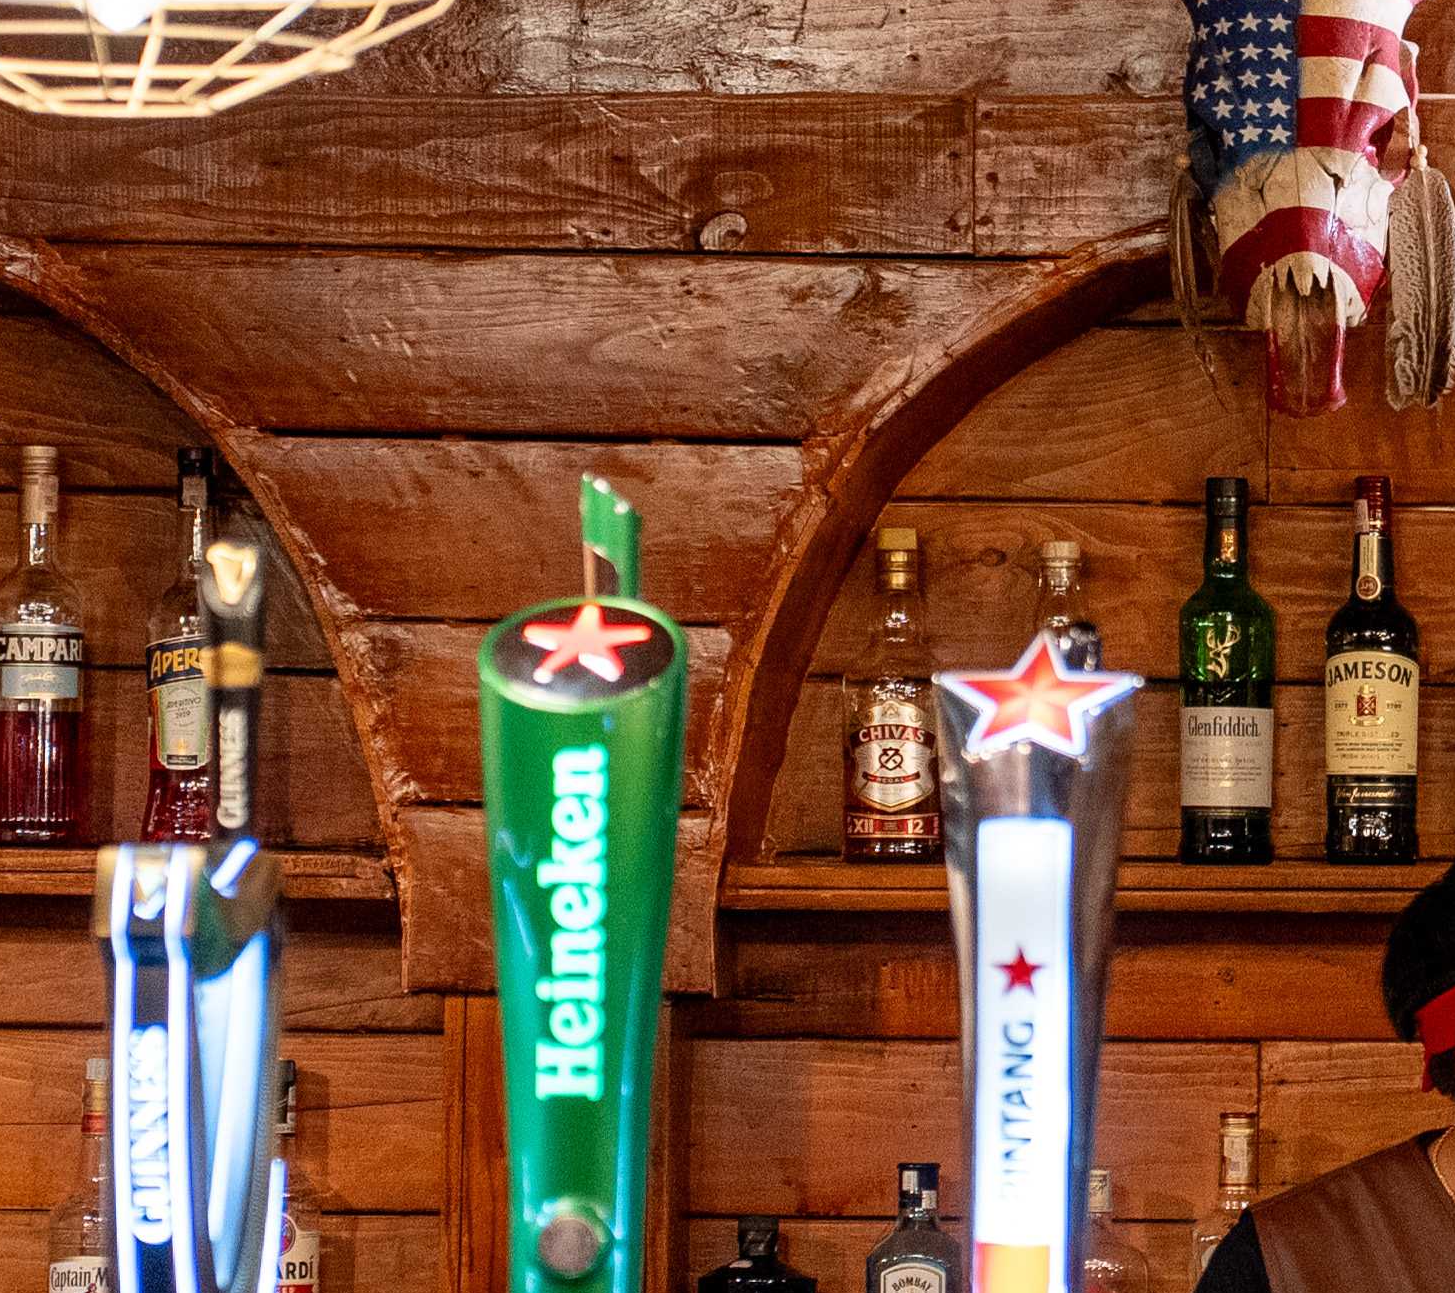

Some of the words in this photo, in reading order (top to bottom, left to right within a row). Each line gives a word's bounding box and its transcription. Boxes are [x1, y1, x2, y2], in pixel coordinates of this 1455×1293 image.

[1327, 660, 1413, 688] JAMESON
[858, 725, 926, 743] CHIVAS
[1187, 715, 1259, 737] Glenfiddich
[853, 818, 875, 834] XII
[907, 818, 924, 834] 12
[536, 742, 610, 1102] Heineken
[1001, 1020, 1035, 1197] INTANG
[50, 1266, 91, 1292] Captain
[891, 1276, 932, 1293] BOMBAY
